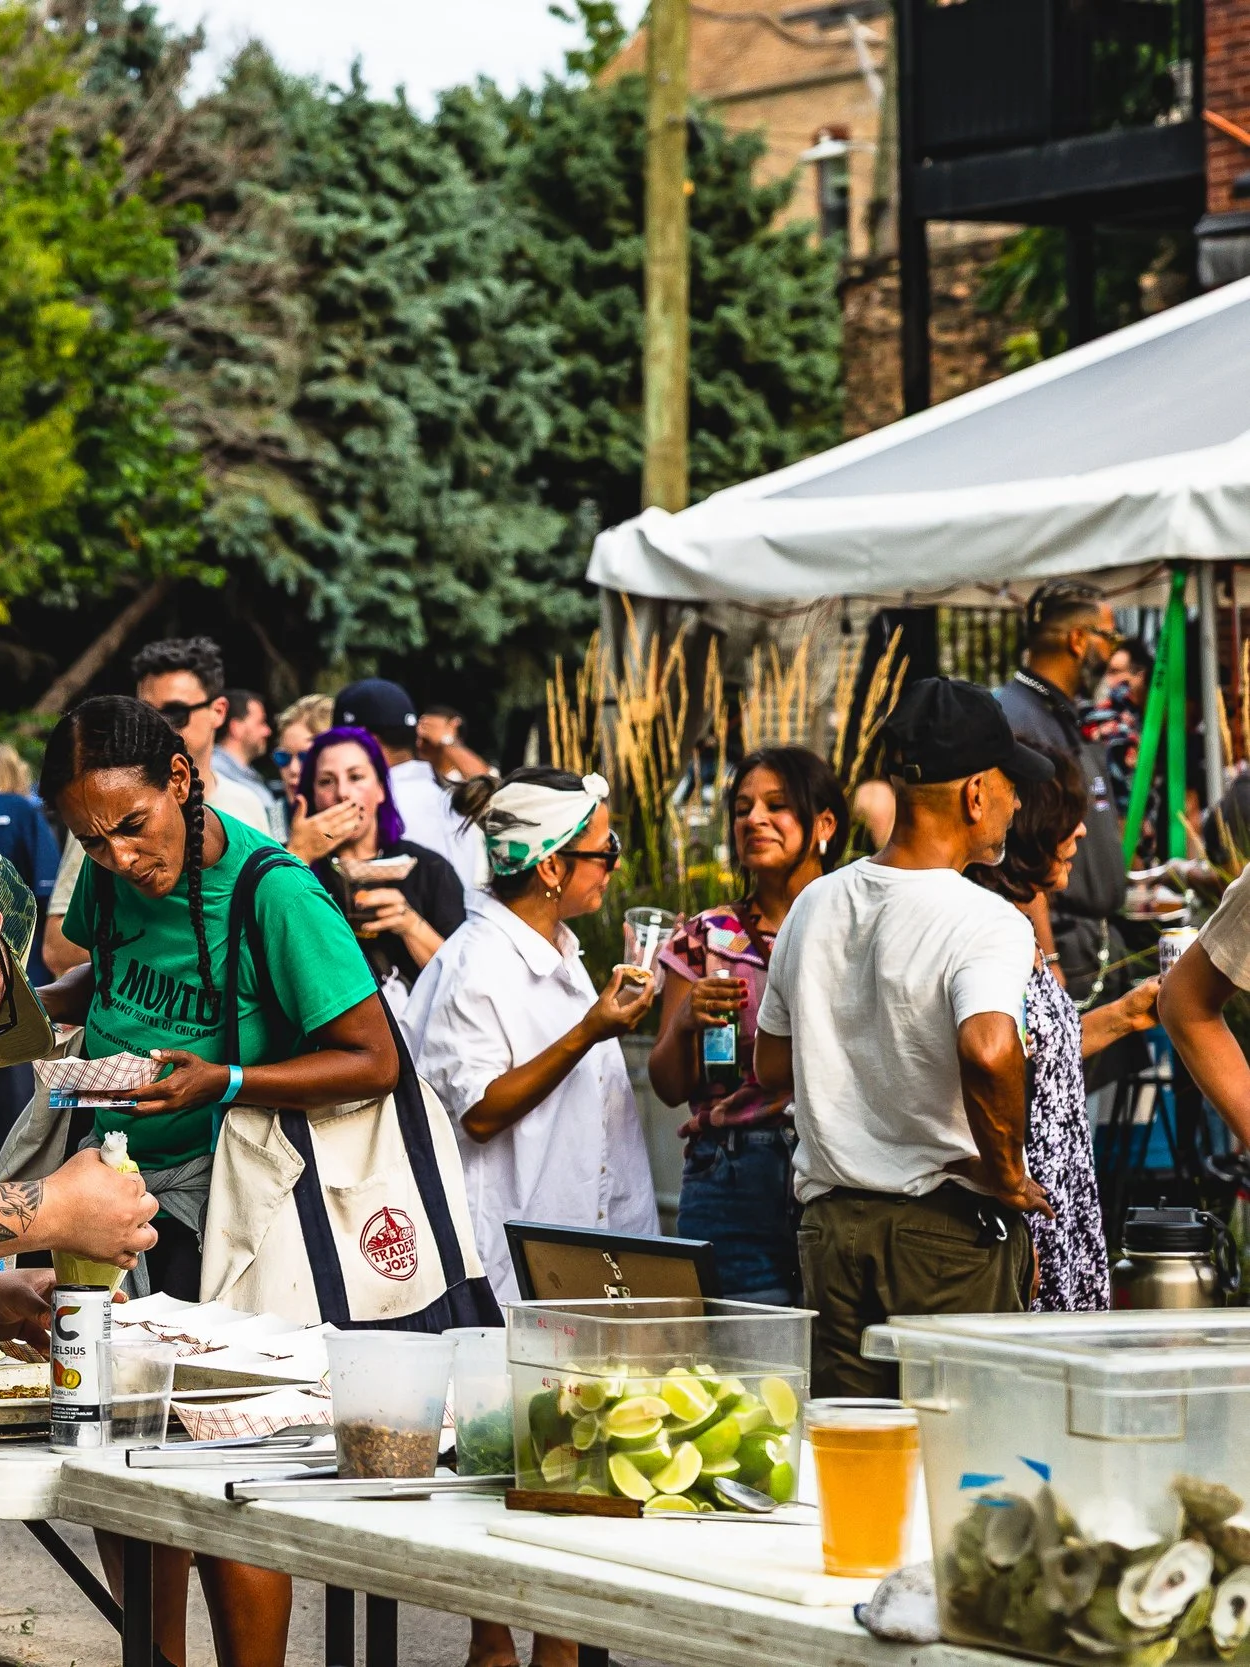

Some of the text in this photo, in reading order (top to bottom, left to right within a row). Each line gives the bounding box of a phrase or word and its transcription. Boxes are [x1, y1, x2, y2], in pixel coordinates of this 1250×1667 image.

[117, 958, 222, 1027] MUNTU
[110, 997, 217, 1038] DANCE THEATRE OF CHICAGO
[371, 1238, 416, 1262] TRADER
[384, 1253, 416, 1273] JOE'S
[52, 1346, 86, 1355] CELSIUS
